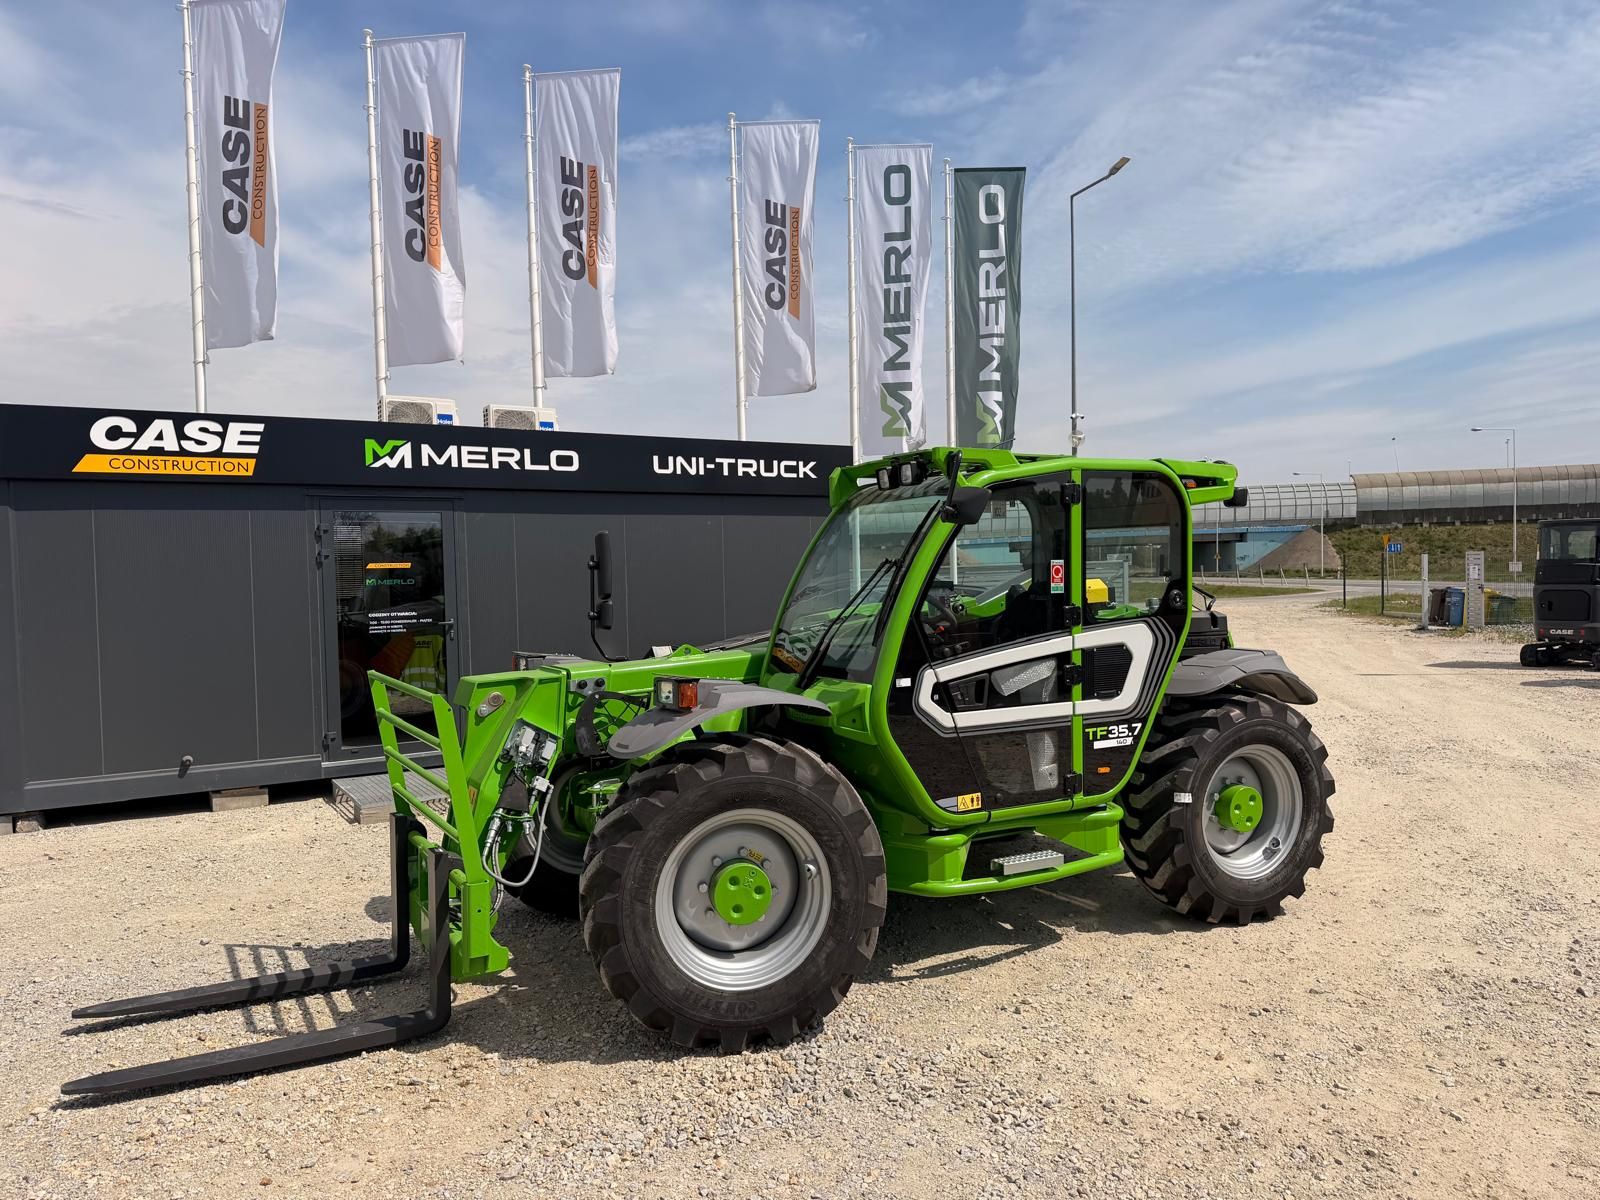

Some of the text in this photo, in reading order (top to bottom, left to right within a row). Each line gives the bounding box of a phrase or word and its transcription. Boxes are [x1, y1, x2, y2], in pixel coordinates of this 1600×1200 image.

[222, 95, 251, 235] CASE
[253, 107, 267, 220] CONSTRUCTION
[403, 129, 426, 263] CASE
[428, 139, 440, 249] CONSTRUCTION
[560, 156, 586, 281] CASE
[587, 168, 597, 268] CONSTRUCTION
[765, 199, 787, 311] CASE
[789, 208, 800, 300] CONSTRUCTION
[883, 163, 912, 372] MERLO
[978, 184, 1006, 387] MERLO
[89, 415, 265, 454] CASE
[108, 457, 250, 473] CONSTRUCTION
[421, 443, 579, 472] MERLO
[652, 455, 818, 479] UNI-TRUCK
[1084, 722, 1142, 741] TF35.7
